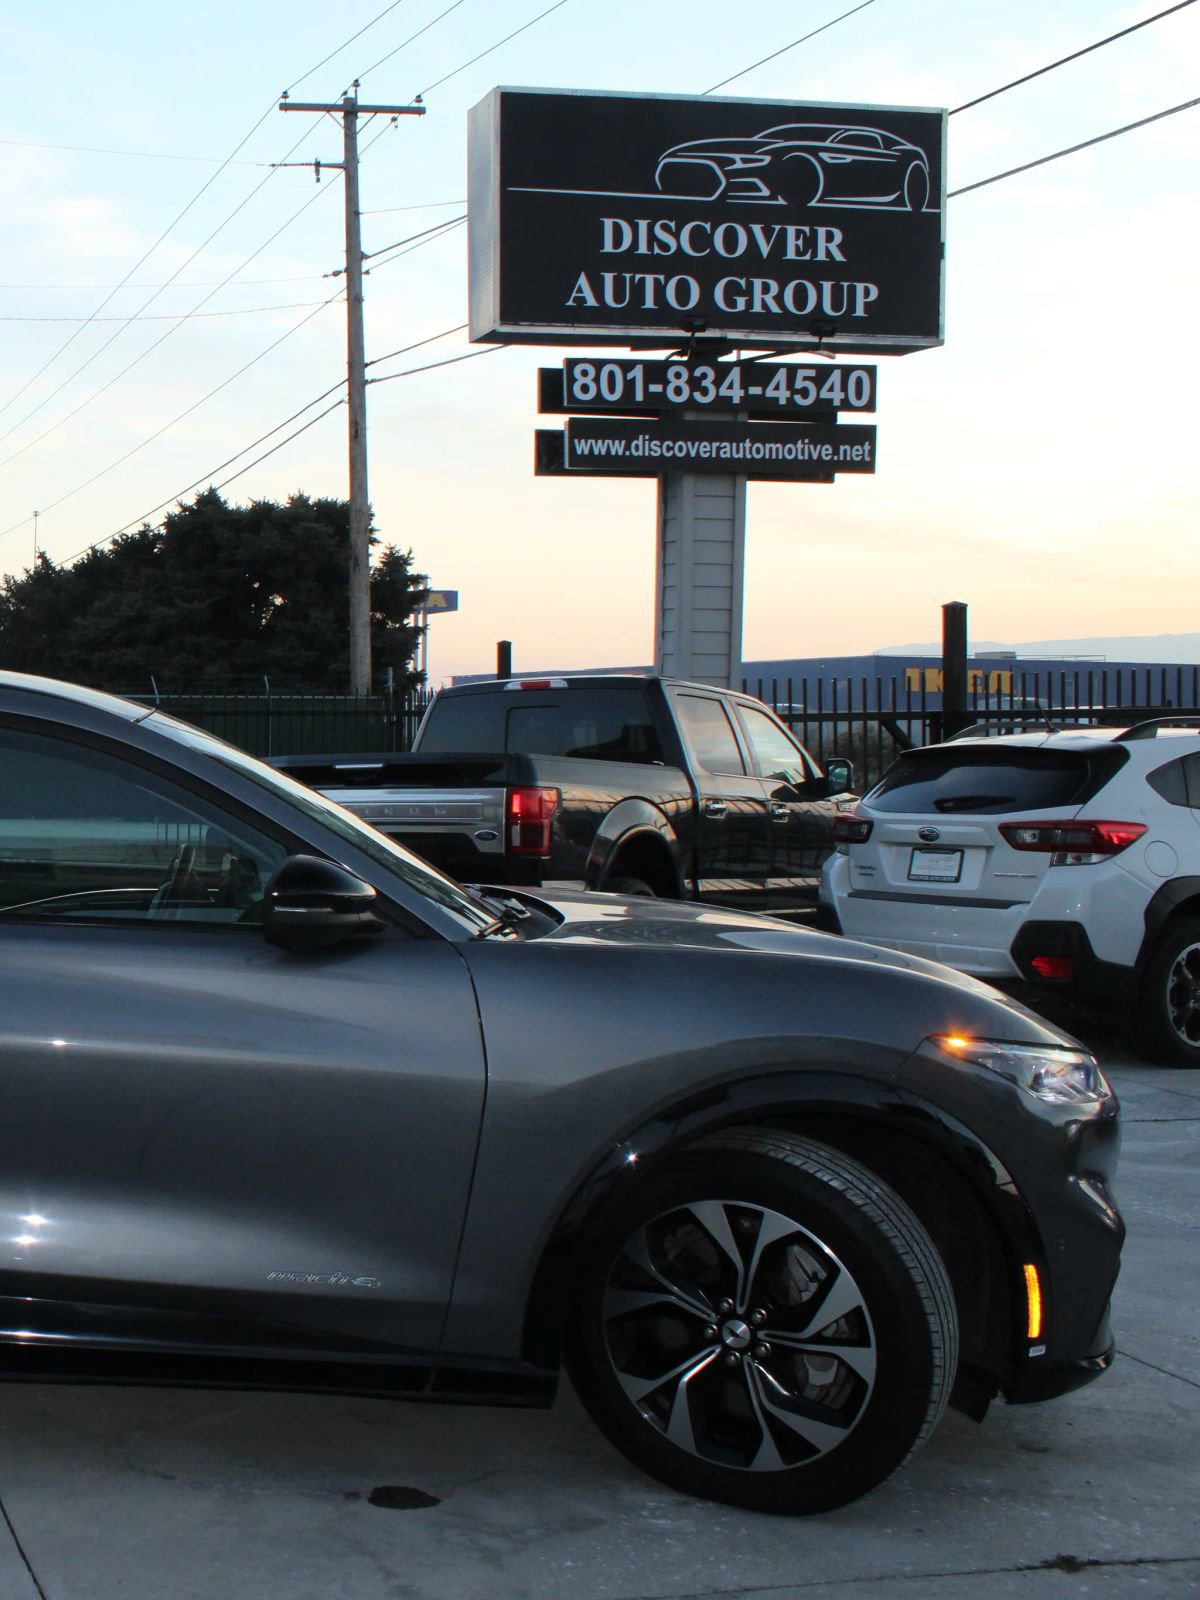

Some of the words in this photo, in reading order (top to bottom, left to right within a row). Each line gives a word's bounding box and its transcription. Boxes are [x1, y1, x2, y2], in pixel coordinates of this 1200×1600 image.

[599, 217, 847, 262] DISCOVER
[565, 271, 701, 311] AUTO
[713, 276, 879, 317] GROUP
[572, 363, 871, 407] 801-834-4540
[573, 434, 872, 462] www.discoverautomotive.net
